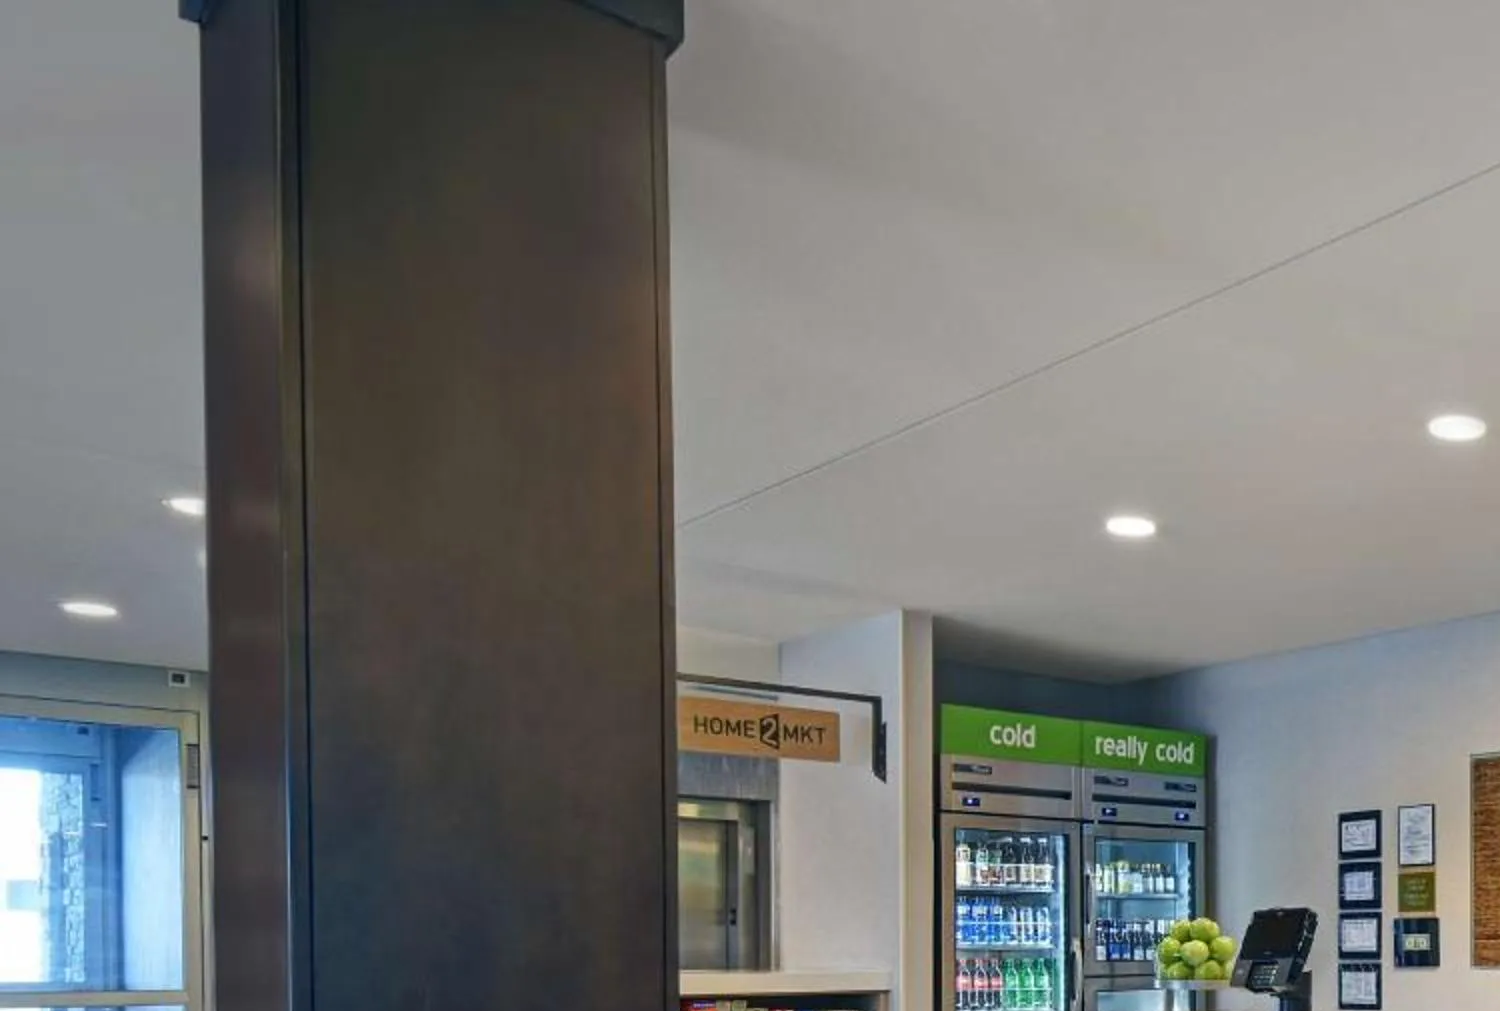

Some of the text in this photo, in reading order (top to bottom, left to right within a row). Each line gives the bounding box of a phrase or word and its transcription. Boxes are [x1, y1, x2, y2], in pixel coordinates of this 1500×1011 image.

[990, 722, 1036, 749] cold
[1094, 734, 1194, 765] really cold
